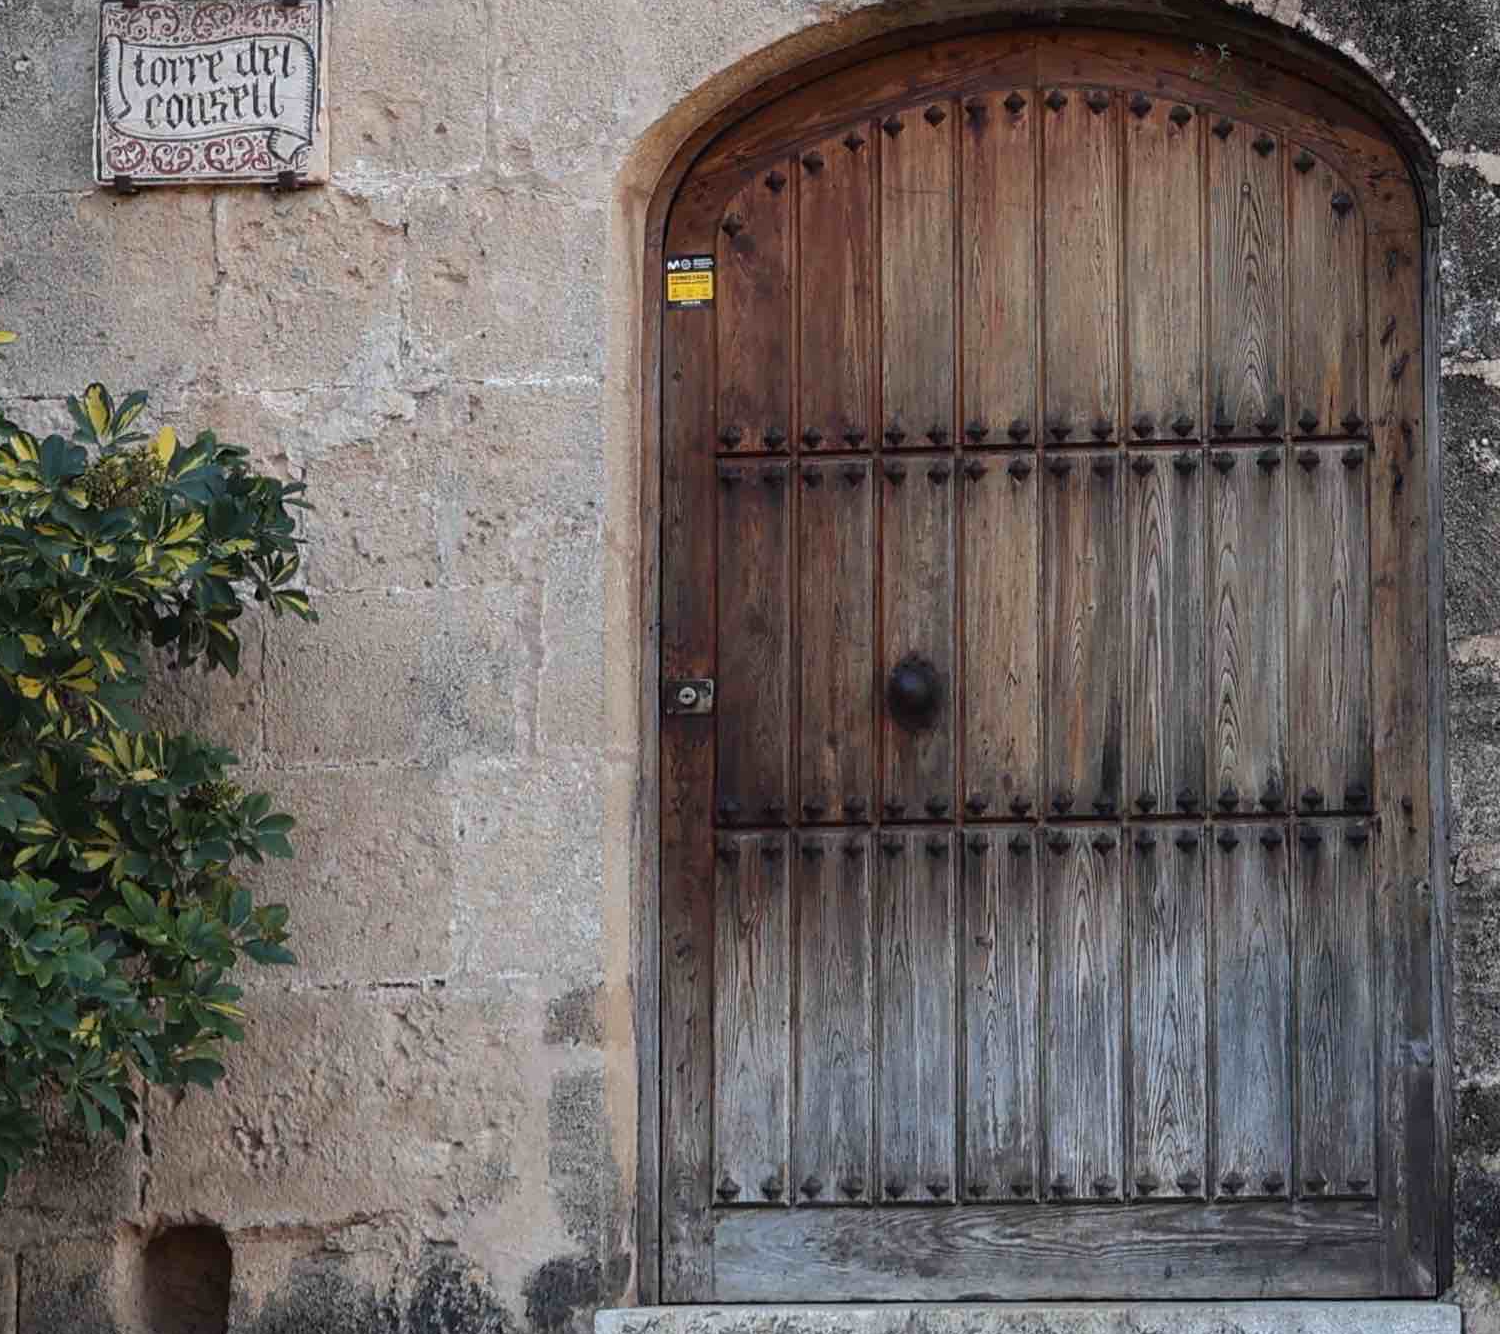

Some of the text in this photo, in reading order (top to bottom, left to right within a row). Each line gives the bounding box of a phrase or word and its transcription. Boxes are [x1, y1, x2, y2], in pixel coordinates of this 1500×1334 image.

[135, 38, 296, 87] torre del
[145, 76, 285, 129] consell
